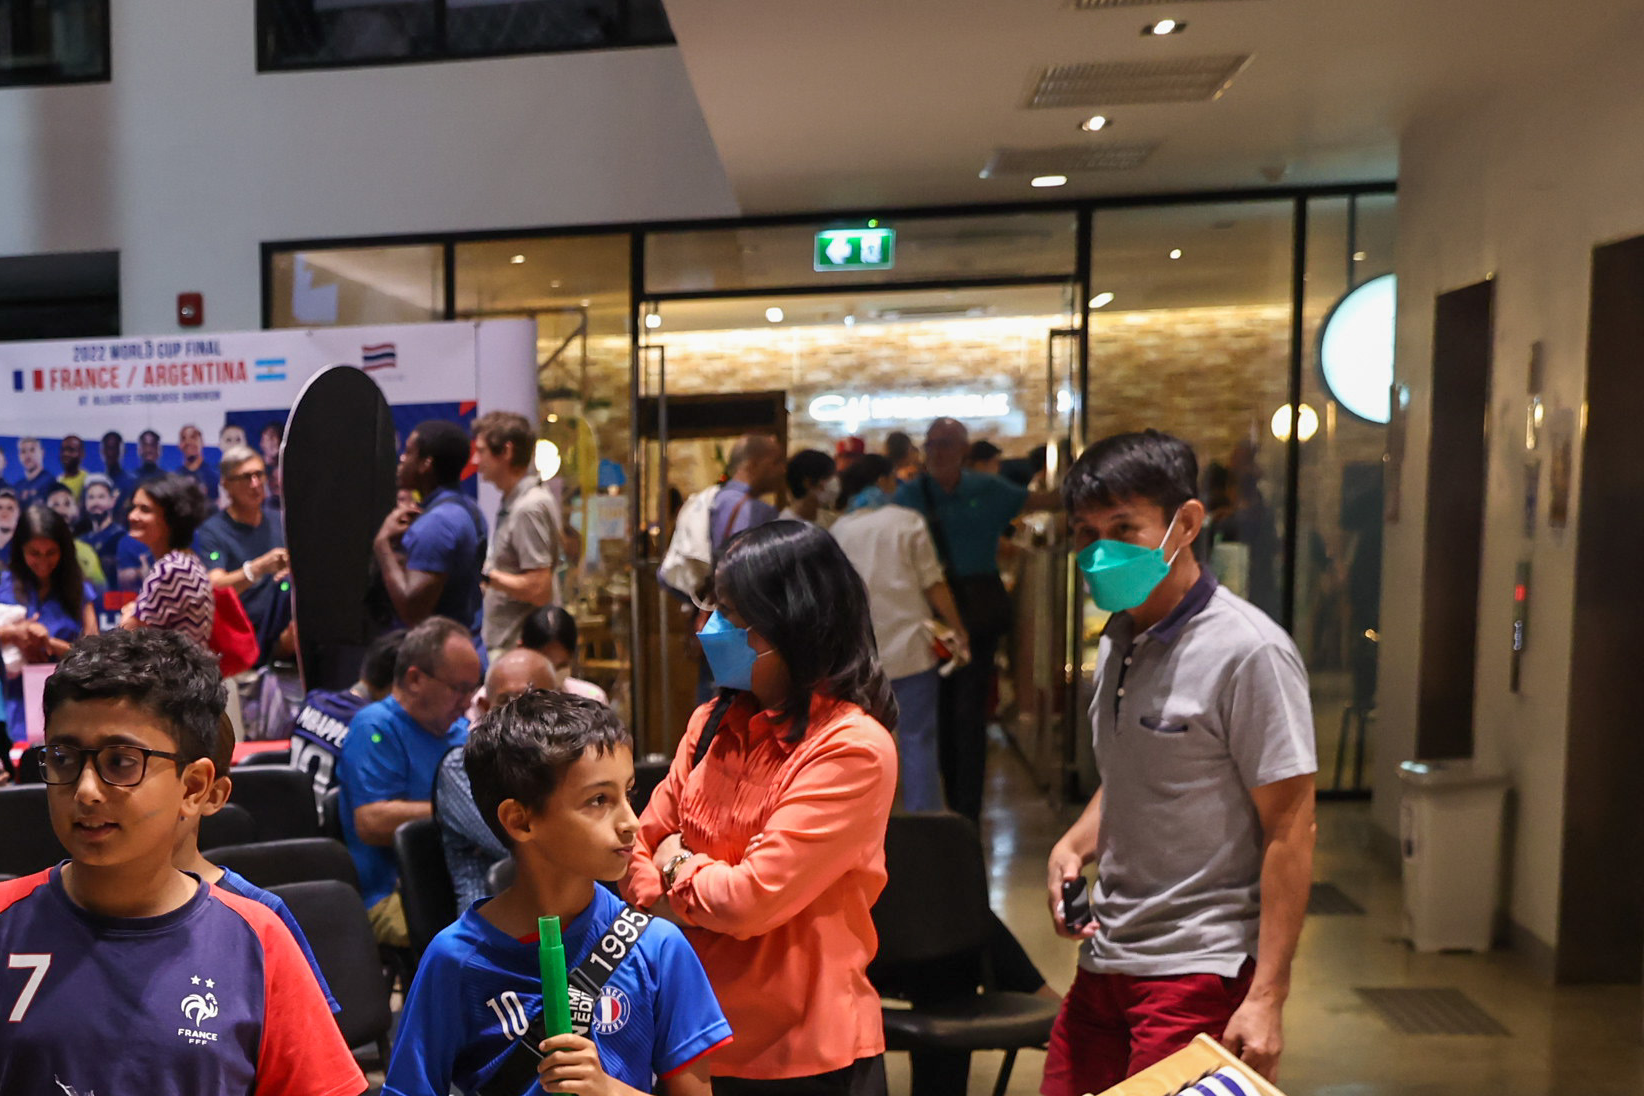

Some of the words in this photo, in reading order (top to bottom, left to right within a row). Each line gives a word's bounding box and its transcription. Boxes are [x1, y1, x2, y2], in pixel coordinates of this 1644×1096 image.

[73, 346, 106, 361] 2022
[109, 342, 154, 360] WORLD
[157, 342, 181, 358] CUP
[185, 341, 221, 356] FINAL
[49, 366, 119, 391] FRANCE
[127, 366, 137, 388] /
[143, 361, 248, 387] ARGENTINA
[8, 953, 52, 1023] 7
[486, 991, 529, 1041] 10
[178, 1028, 218, 1041] FRANCE
[189, 1038, 207, 1046] FFF
